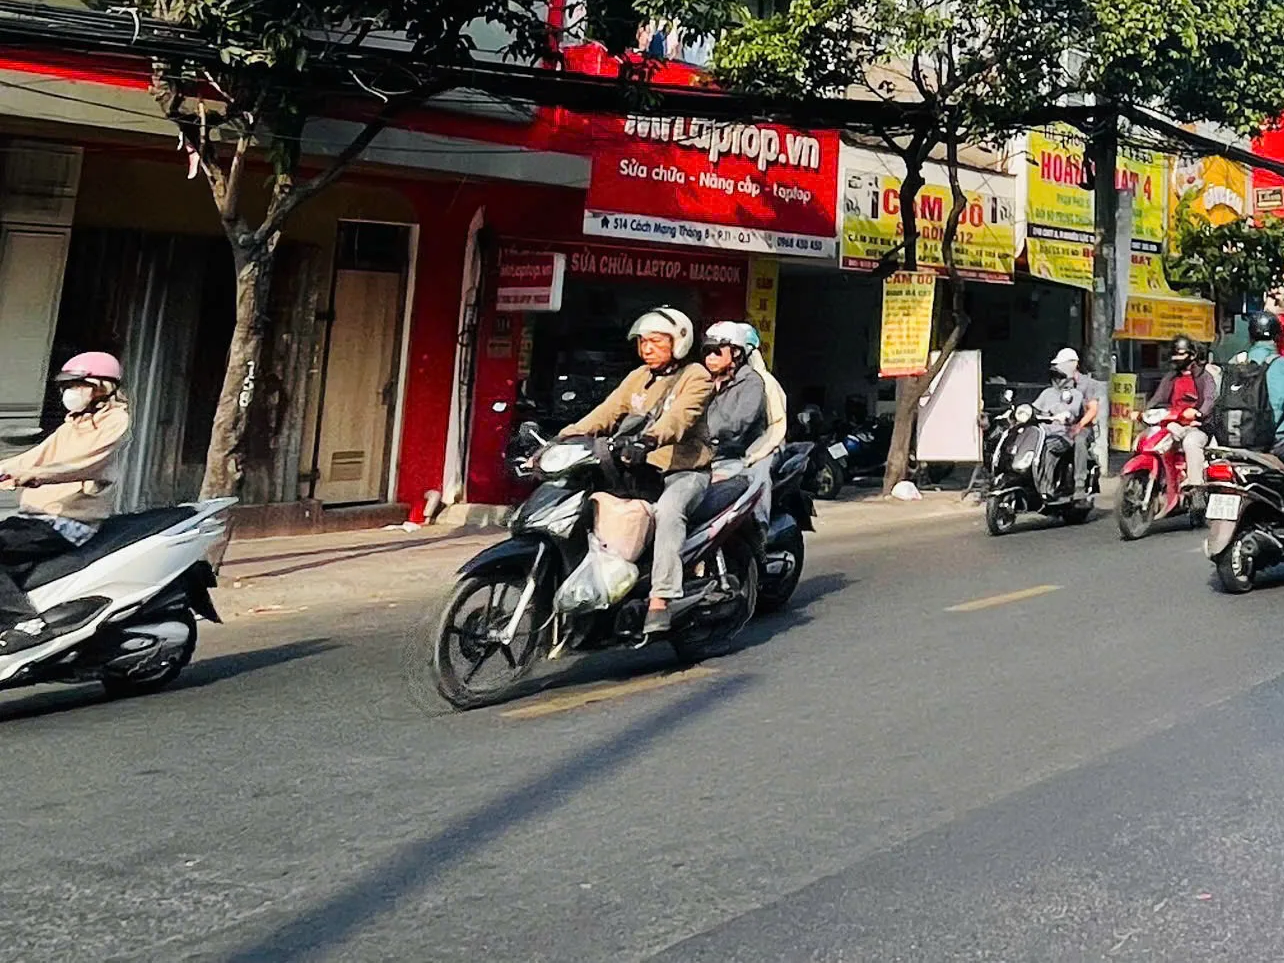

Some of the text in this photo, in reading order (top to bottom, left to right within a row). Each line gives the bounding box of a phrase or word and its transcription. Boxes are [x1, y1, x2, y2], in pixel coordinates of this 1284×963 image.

[619, 157, 648, 178] Sửa
[652, 164, 685, 185] chữa
[699, 172, 735, 195] Nâng
[1144, 176, 1152, 201] 4
[613, 218, 628, 230] 514
[570, 246, 597, 273] SỬA
[599, 252, 634, 276] CHỮA
[636, 258, 681, 280] LAPTOP
